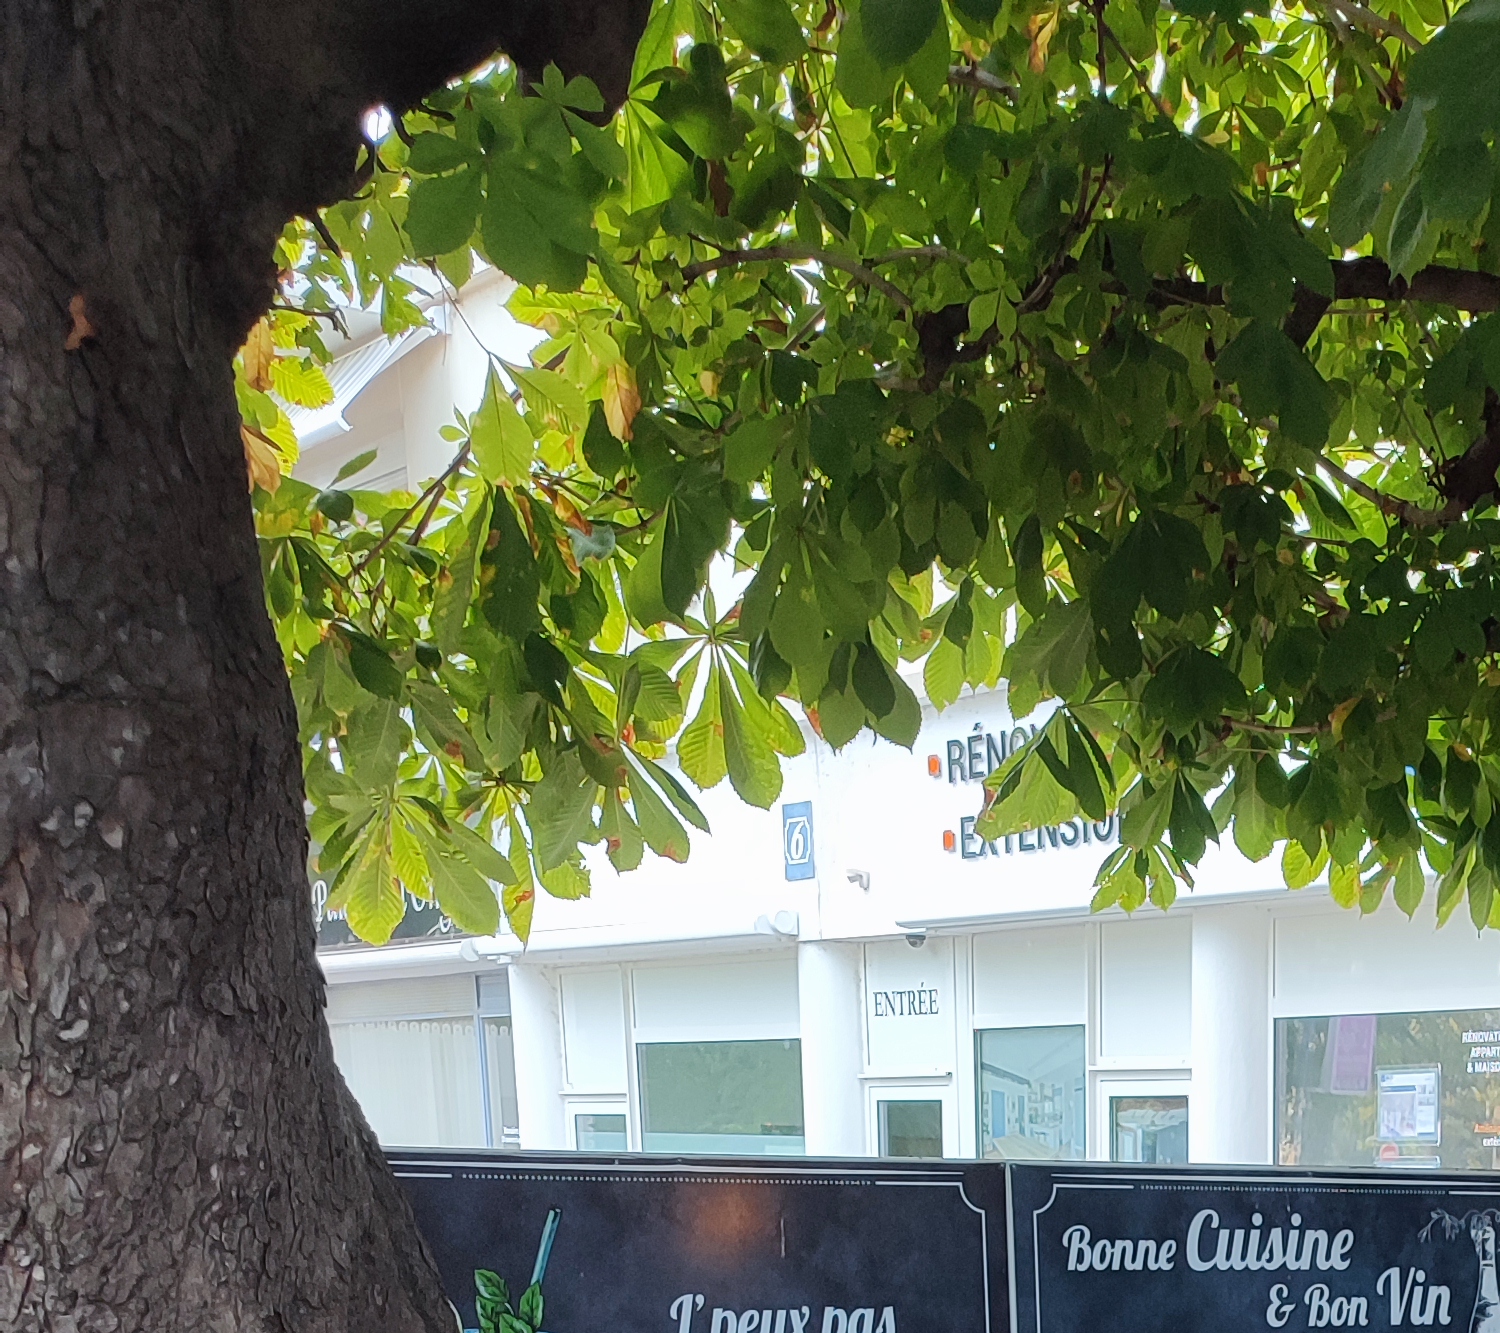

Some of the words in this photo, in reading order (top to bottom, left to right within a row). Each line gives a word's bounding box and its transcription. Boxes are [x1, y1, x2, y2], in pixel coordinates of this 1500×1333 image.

[946, 721, 1038, 784] RÉNO
[789, 821, 806, 857] 6
[872, 982, 940, 1018] ENTRÉE
[1062, 1224, 1177, 1272] Bonne
[1185, 1208, 1355, 1272] Cuisine
[1265, 1283, 1296, 1328] &
[1303, 1283, 1369, 1328] Bon
[1376, 1265, 1452, 1326] Vin
